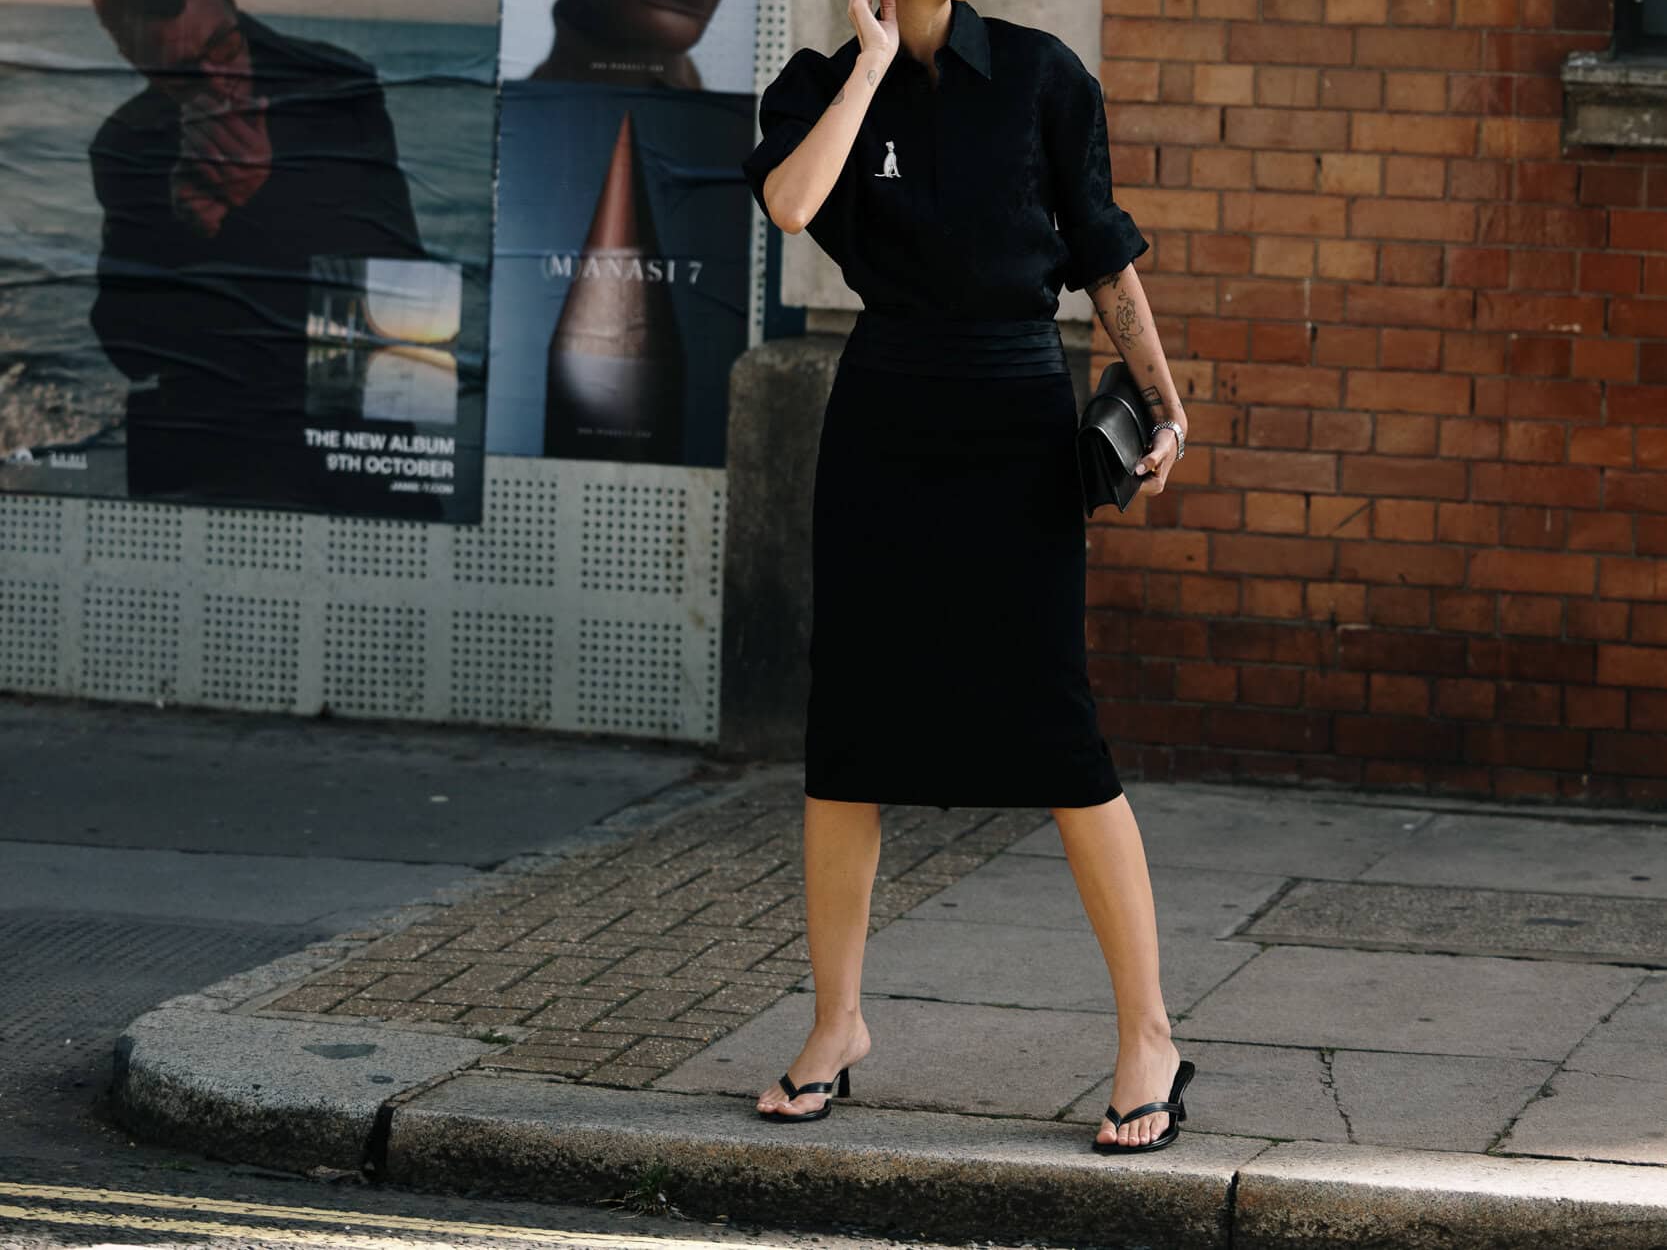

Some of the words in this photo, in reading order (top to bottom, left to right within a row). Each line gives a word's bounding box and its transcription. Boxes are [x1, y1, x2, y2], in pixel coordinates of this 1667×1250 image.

[688, 261, 702, 284] 7
[304, 428, 341, 448] THE
[343, 432, 386, 451] NEW
[389, 435, 455, 455] ALBUM
[326, 454, 361, 472] 9TH
[364, 456, 454, 478] OCTOBER
